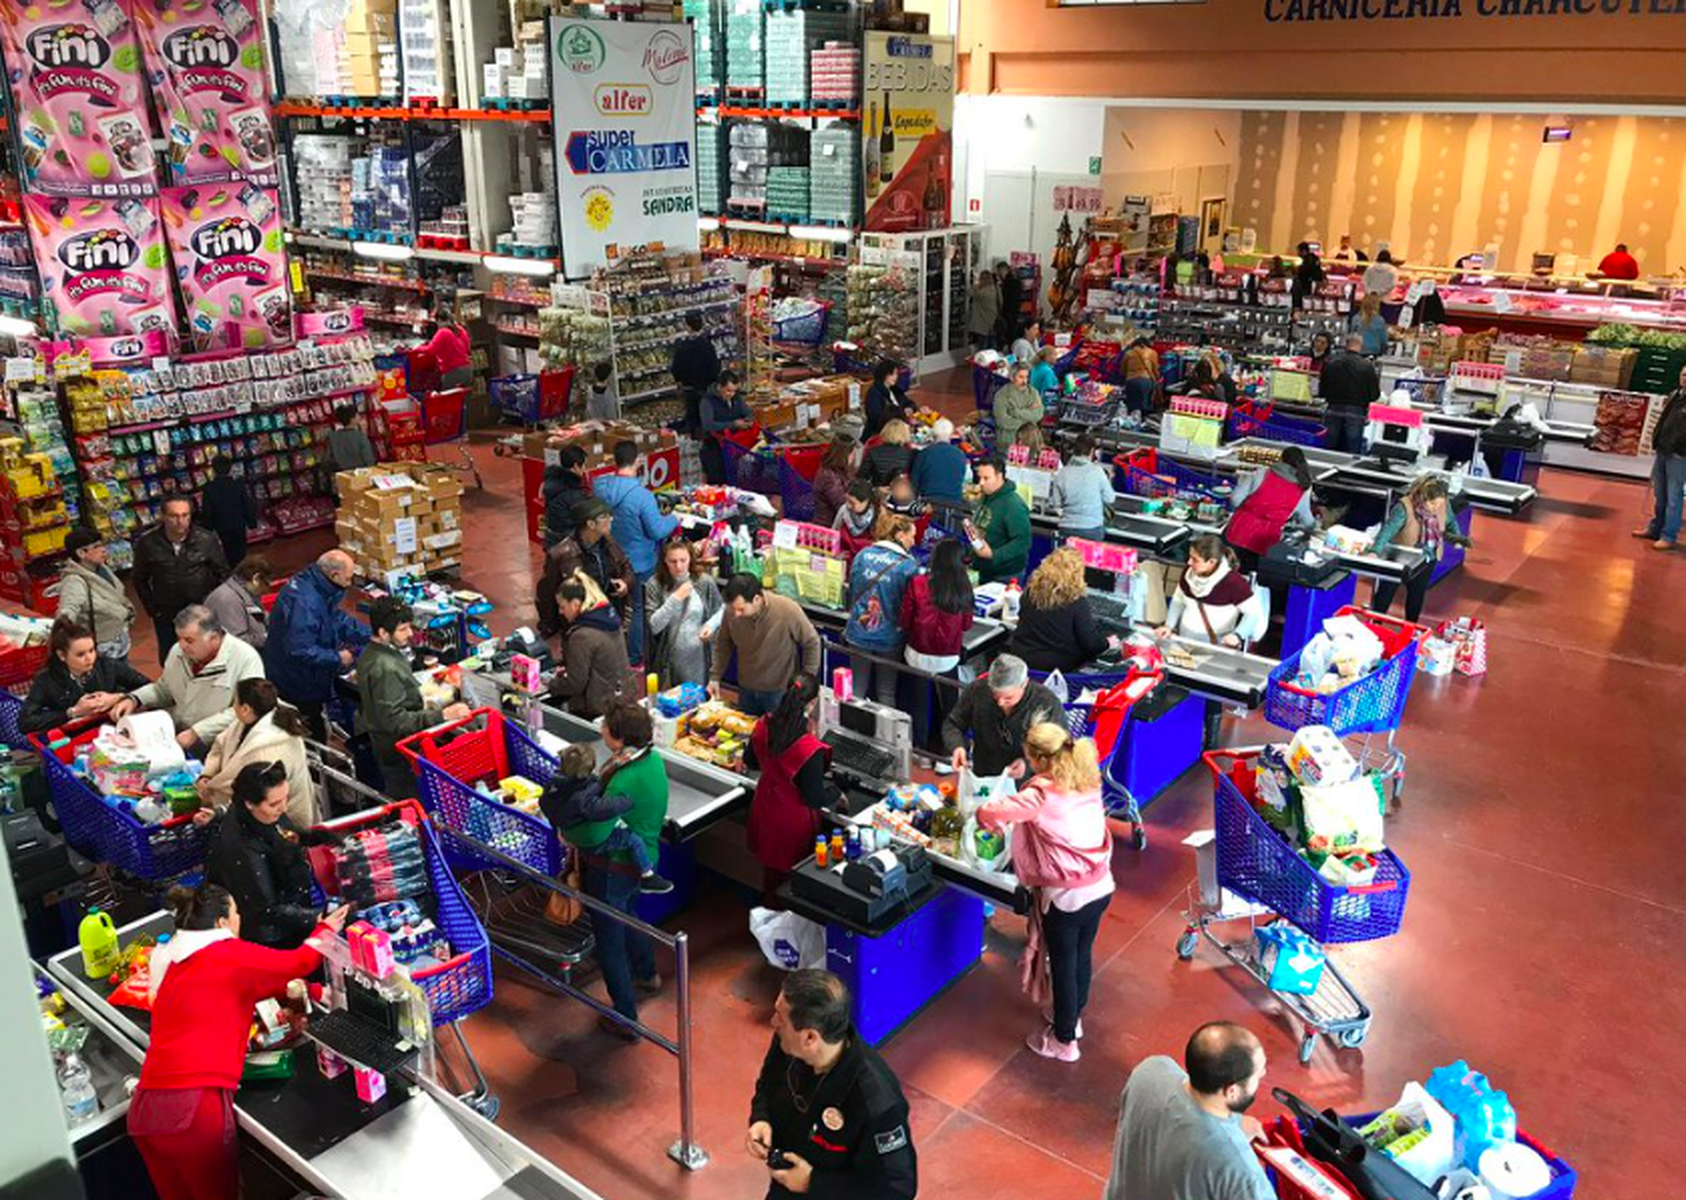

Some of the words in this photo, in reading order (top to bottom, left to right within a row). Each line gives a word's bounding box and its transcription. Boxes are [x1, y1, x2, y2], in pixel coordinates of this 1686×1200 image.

[33, 29, 101, 66] Fini
[170, 31, 231, 66] Fini
[602, 89, 647, 110] alfer
[588, 130, 635, 147] super
[590, 146, 689, 172] CARMELA
[643, 195, 694, 216] SANDRA
[66, 233, 130, 270] Fini
[198, 220, 254, 256] Fini
